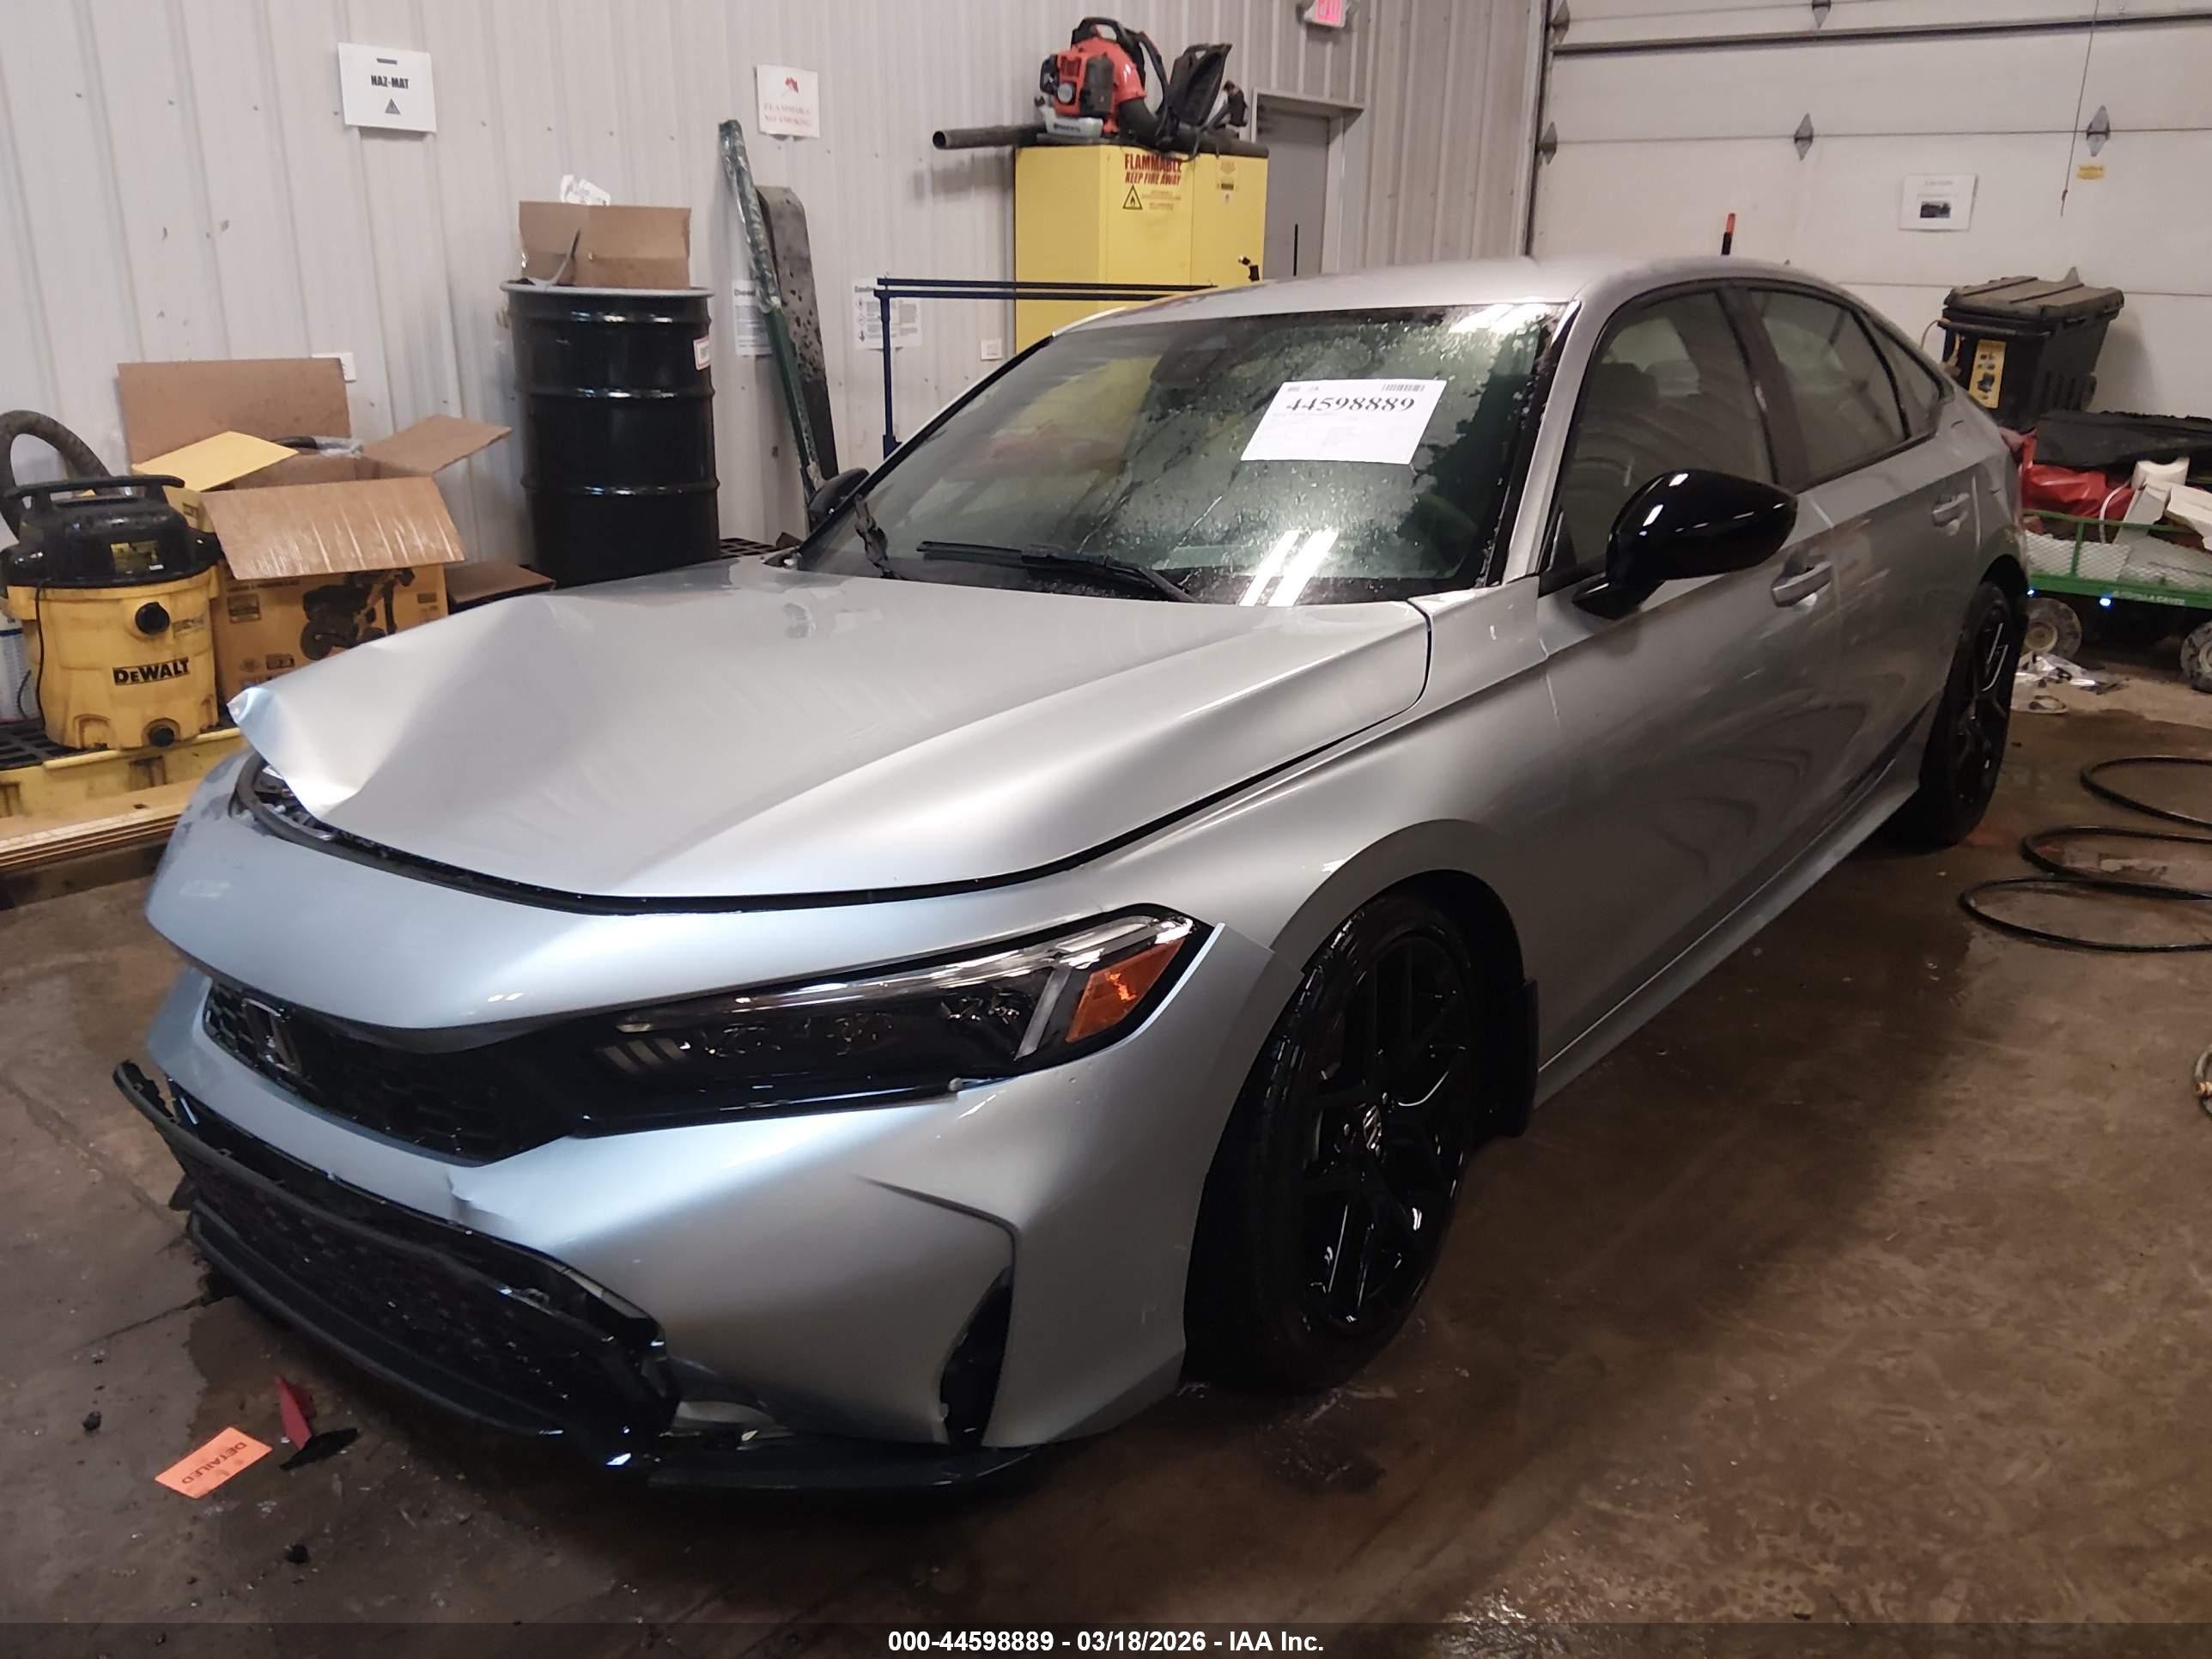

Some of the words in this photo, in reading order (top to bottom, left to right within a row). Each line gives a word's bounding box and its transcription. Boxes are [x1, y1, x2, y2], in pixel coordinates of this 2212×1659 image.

[370, 75, 409, 89] HAZ-MAT
[1125, 153, 1182, 173] FLAMMABLE
[1125, 171, 1143, 184] KEEP
[1144, 172, 1160, 185] FIRE
[1160, 173, 1182, 185] AWAY
[1285, 397, 1415, 412] 44598889
[181, 1442, 247, 1484] DETAILED
